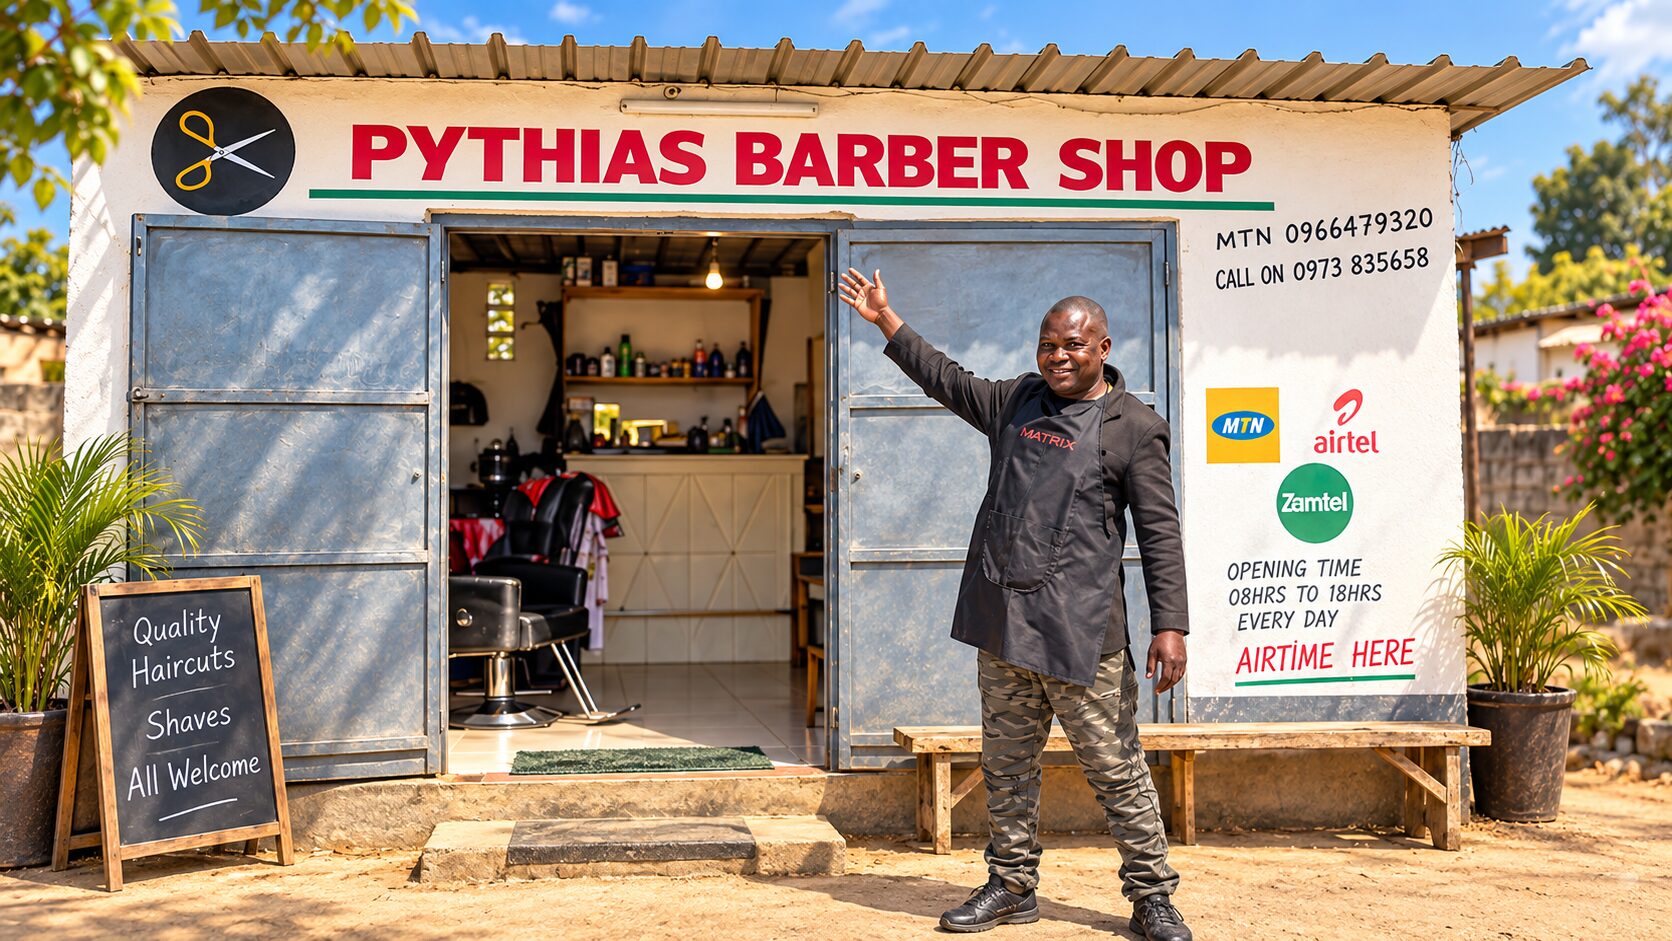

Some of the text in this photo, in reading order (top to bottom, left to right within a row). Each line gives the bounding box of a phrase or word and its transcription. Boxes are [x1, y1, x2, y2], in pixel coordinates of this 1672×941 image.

[352, 124, 1253, 193] PYTHIAS BARBER SHOP
[1216, 207, 1433, 251] MTN 0966479320
[1215, 247, 1429, 290] CALL ON 0973 835658
[1020, 427, 1077, 451] MATRIX
[1222, 417, 1265, 434] MTN
[1313, 430, 1379, 454] airtel
[1281, 492, 1348, 513] Zamtel
[1227, 558, 1363, 581] OPENING TIME
[1228, 583, 1382, 606] 08HRS TO 18HRS
[133, 608, 221, 646] Quality
[1237, 609, 1339, 631] EVERY DAY
[132, 645, 236, 689] Haircuts
[1352, 637, 1416, 668] HERE
[146, 706, 231, 740] Shaves
[127, 755, 261, 801] All Welcome
